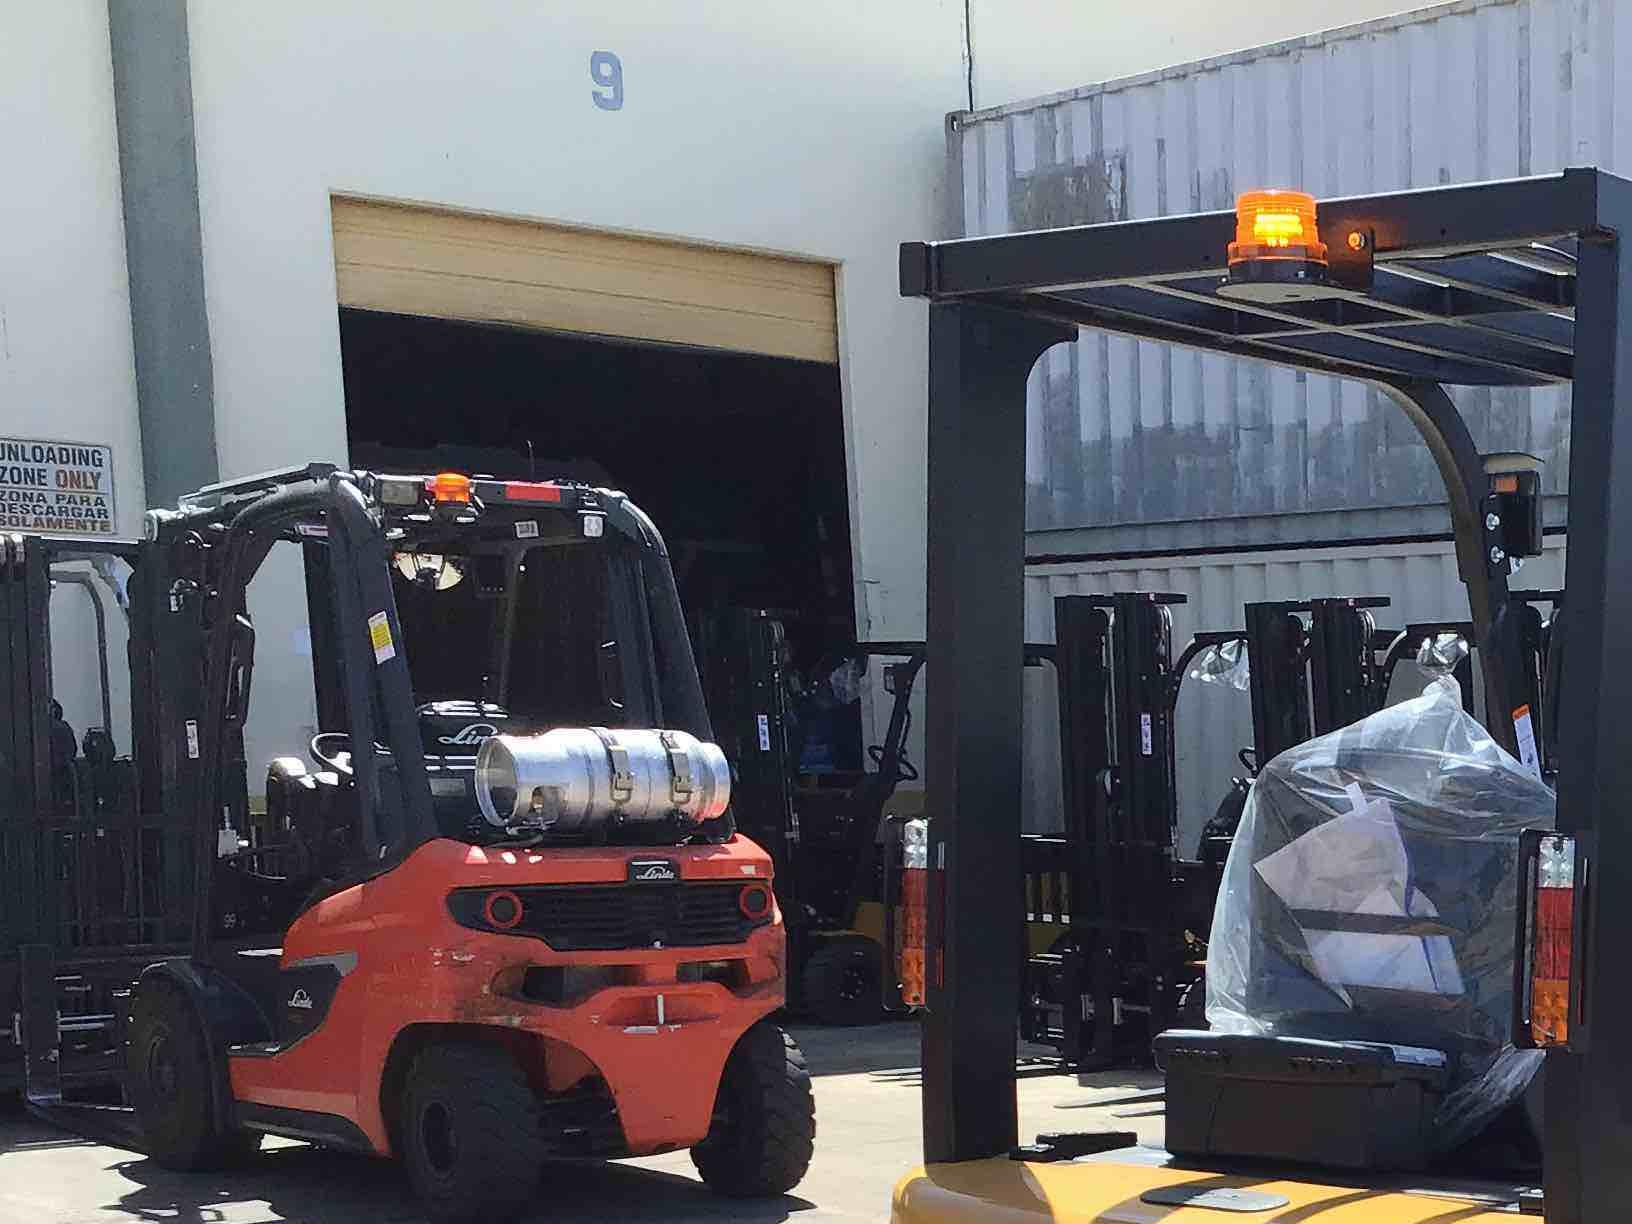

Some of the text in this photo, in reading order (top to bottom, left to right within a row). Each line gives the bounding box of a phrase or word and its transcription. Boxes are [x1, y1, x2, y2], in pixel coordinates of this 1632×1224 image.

[590, 50, 625, 111] 9
[0, 466, 101, 490] ZONE ONLY
[0, 491, 106, 507] ZONA PARA
[0, 515, 112, 532] SOLAMENTE
[438, 723, 498, 745] Lin
[636, 866, 674, 880] Linde
